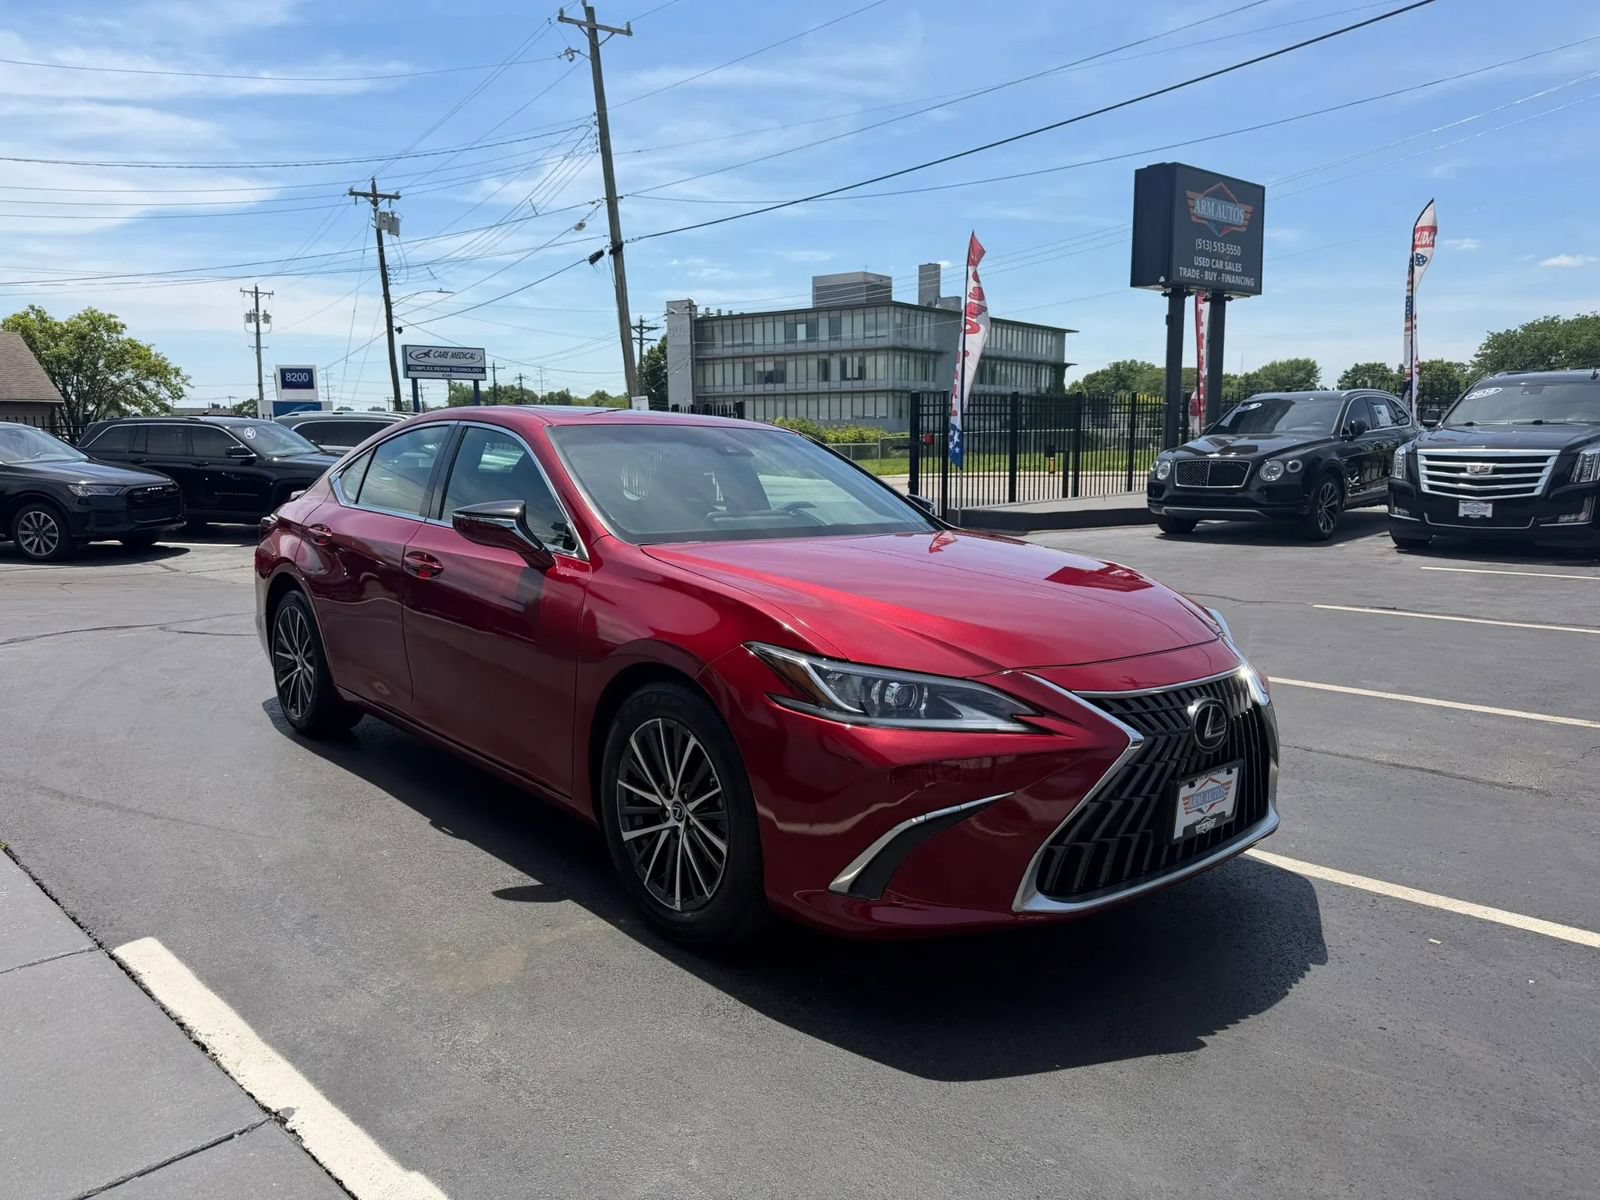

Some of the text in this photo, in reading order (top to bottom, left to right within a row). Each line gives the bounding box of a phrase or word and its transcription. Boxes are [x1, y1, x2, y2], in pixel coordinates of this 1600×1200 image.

[1195, 198, 1245, 224] ARM AUTOS
[1195, 238, 1241, 256] (513) 513-5550
[1194, 256, 1242, 272] USED CAR SALES
[1179, 266, 1200, 279] TRADE
[1204, 270, 1218, 281] BUY
[1221, 273, 1255, 287] FINANCING
[433, 350, 476, 360] CARE MEDICAL
[285, 372, 309, 382] 8200
